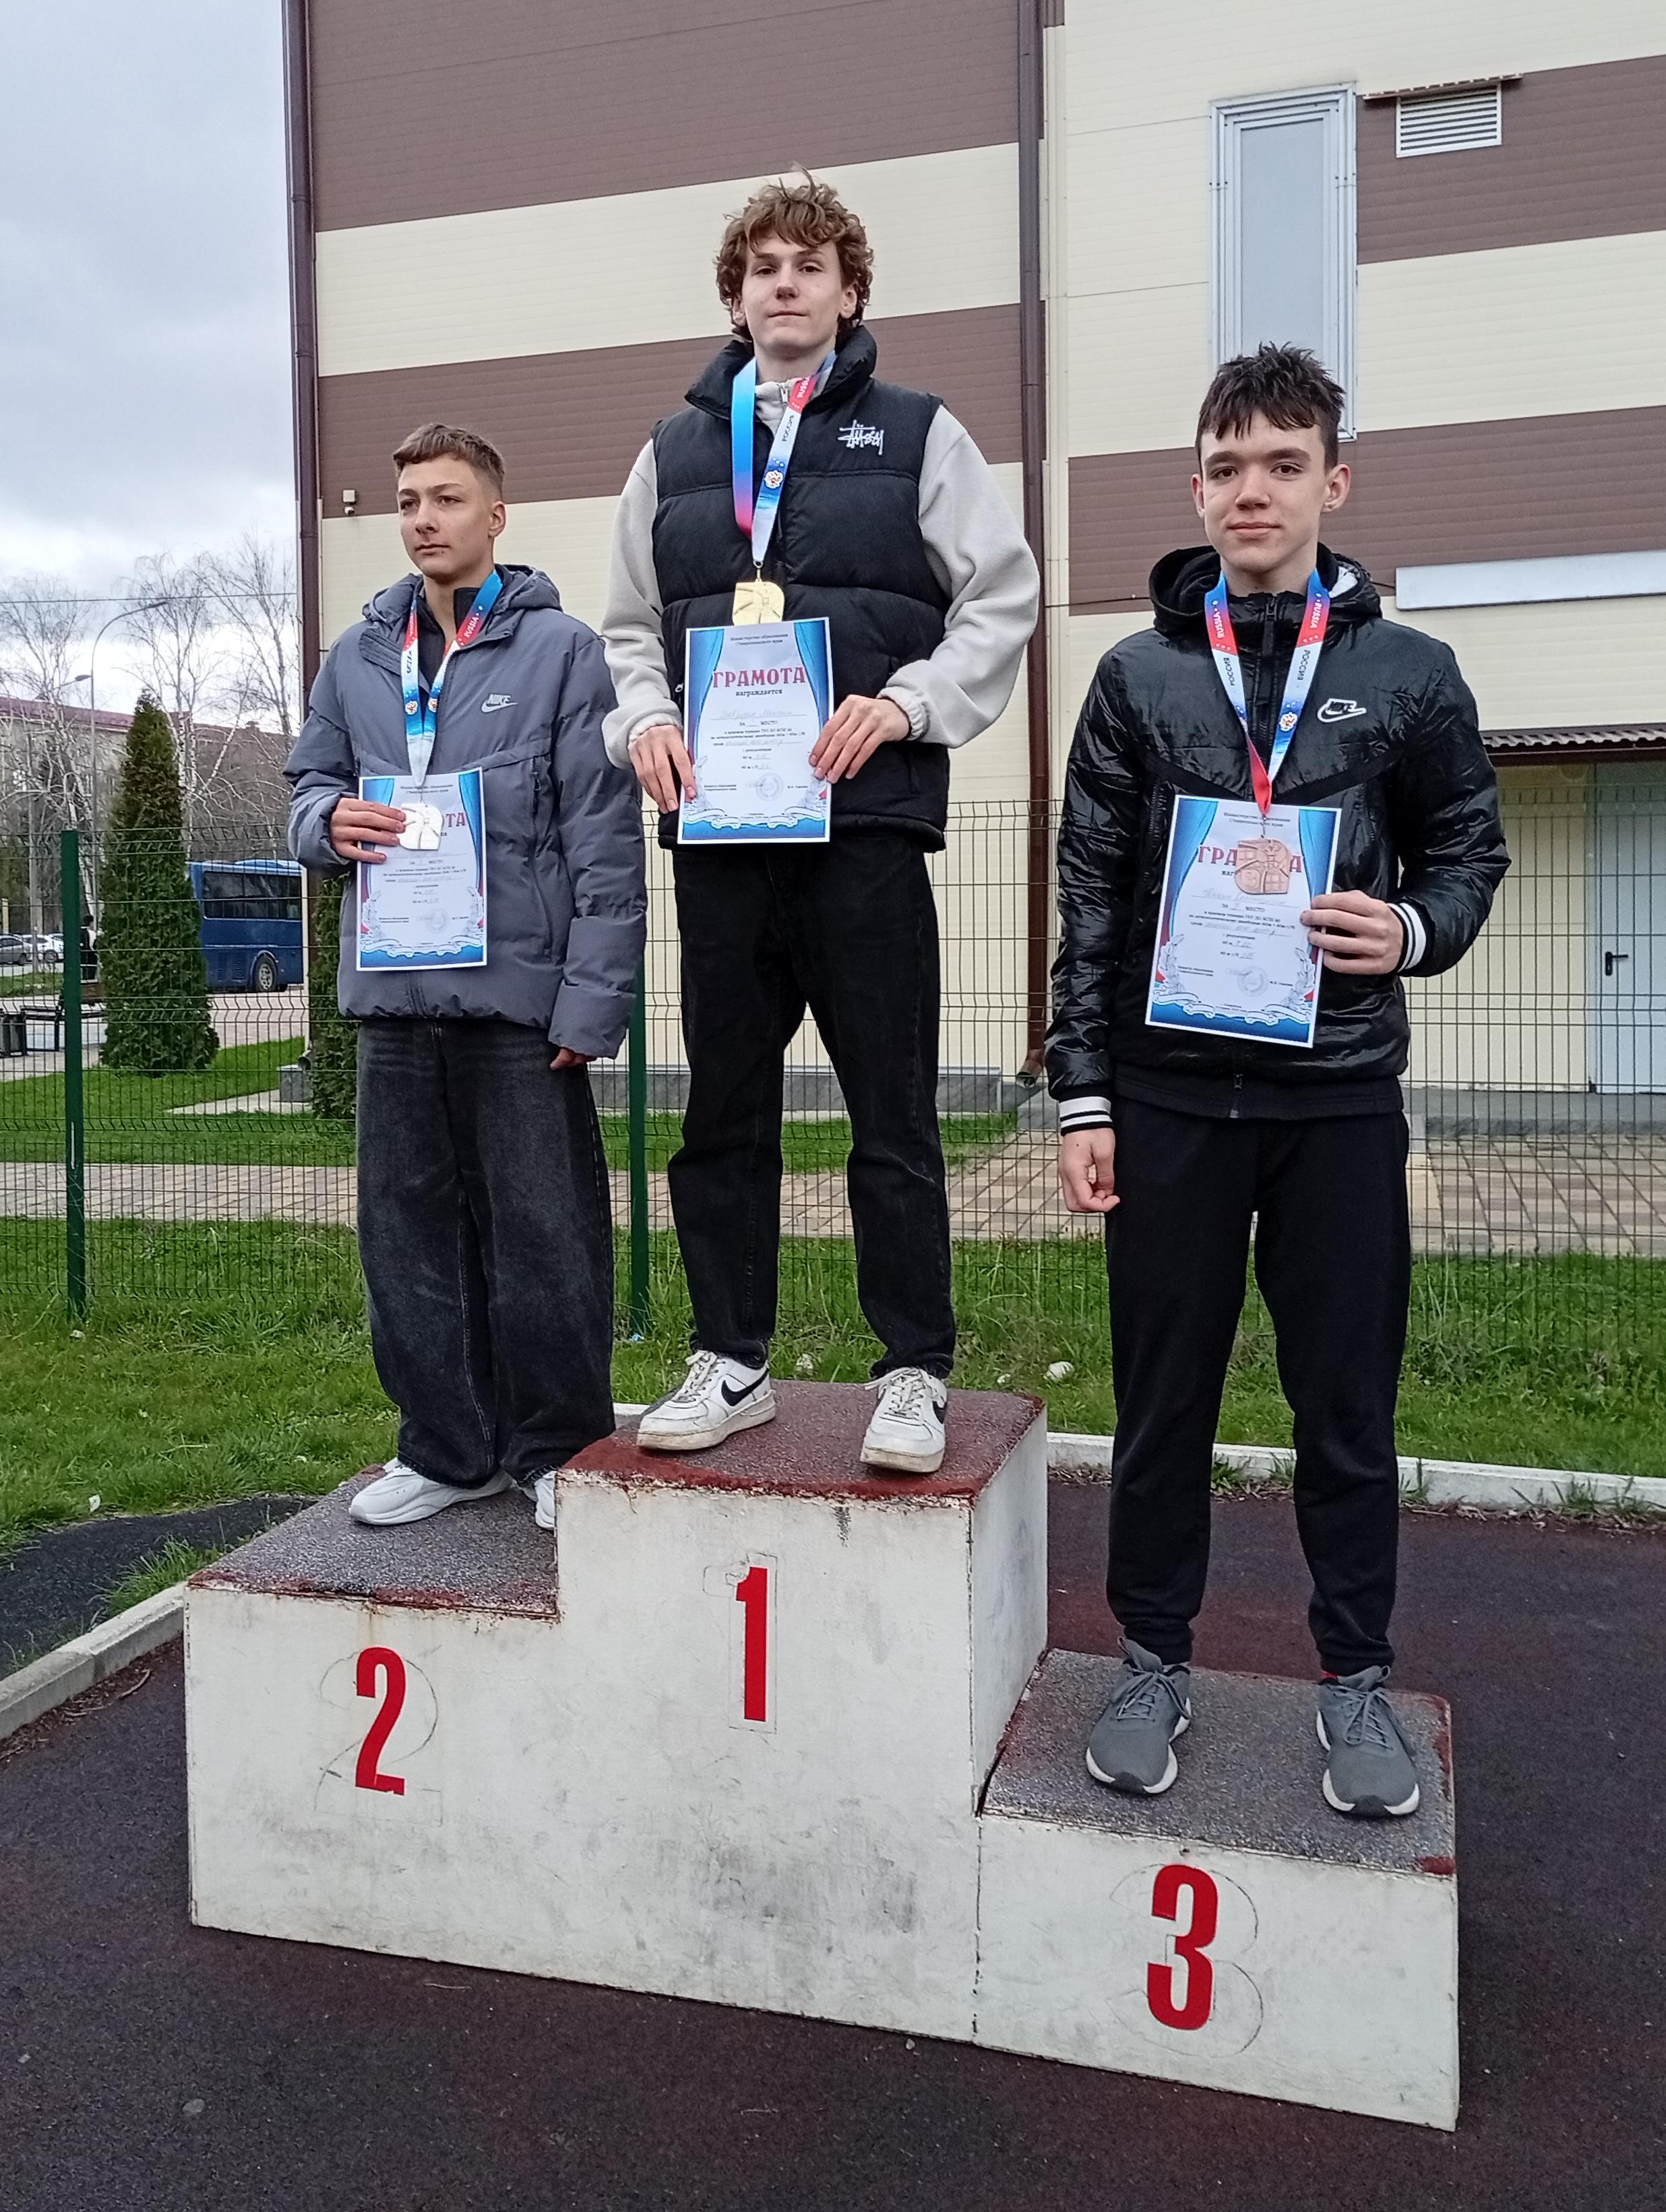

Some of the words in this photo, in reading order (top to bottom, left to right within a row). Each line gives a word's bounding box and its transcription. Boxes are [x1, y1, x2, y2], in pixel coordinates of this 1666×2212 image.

[464, 617, 479, 639] RUSSIA
[1213, 611, 1225, 639] RUSSIA
[1309, 602, 1322, 629] RUSSIA
[713, 666, 806, 688] ГРАМОТА
[1223, 657, 1235, 686] РОССИЯ
[1297, 649, 1311, 681] РОССИЯ
[487, 693, 512, 707] NIKE
[1198, 846, 1302, 873] ГРАА
[736, 1567, 767, 1722] 1
[356, 1647, 406, 1796] 2
[1147, 1864, 1218, 2030] 3
